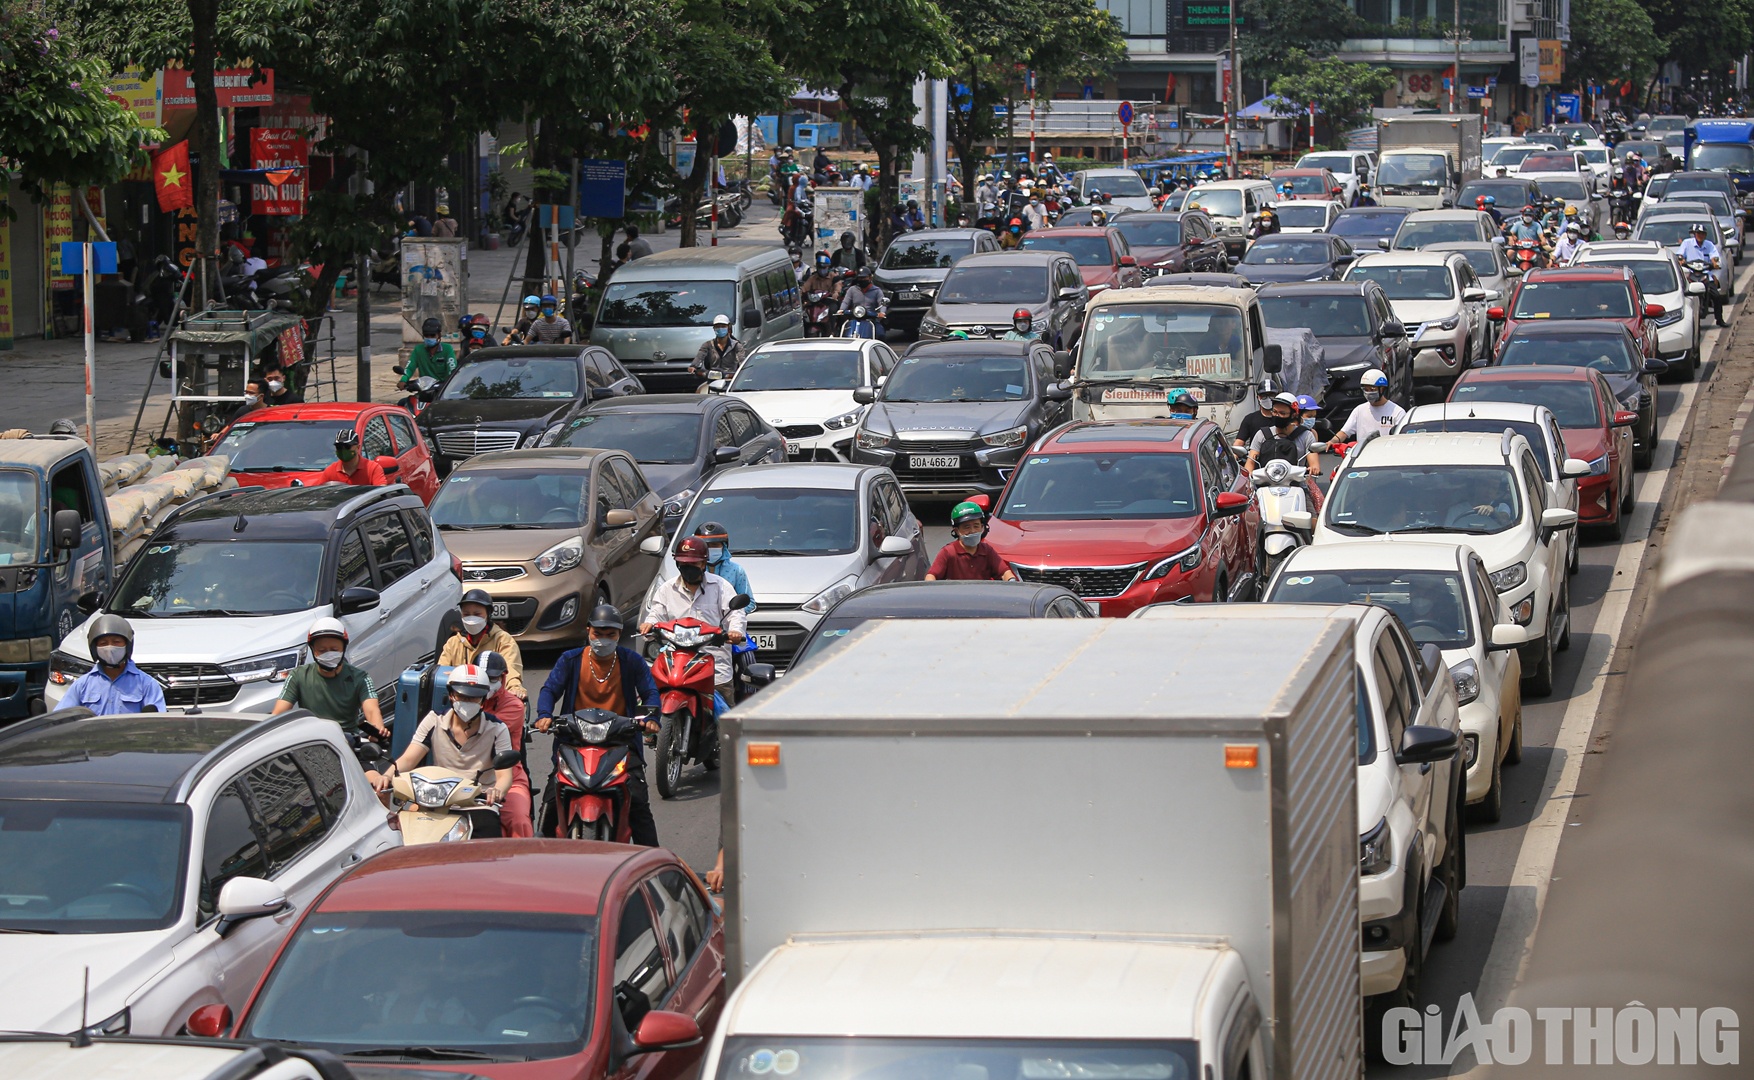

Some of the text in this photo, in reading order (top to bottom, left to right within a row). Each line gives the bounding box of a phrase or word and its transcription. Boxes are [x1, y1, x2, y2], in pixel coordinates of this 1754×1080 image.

[1187, 6, 1220, 14] THEANH
[1408, 74, 1433, 93] 93
[1187, 356, 1231, 376] HANH XI
[1380, 415, 1393, 425] 04
[911, 456, 959, 468] 30A-466.27
